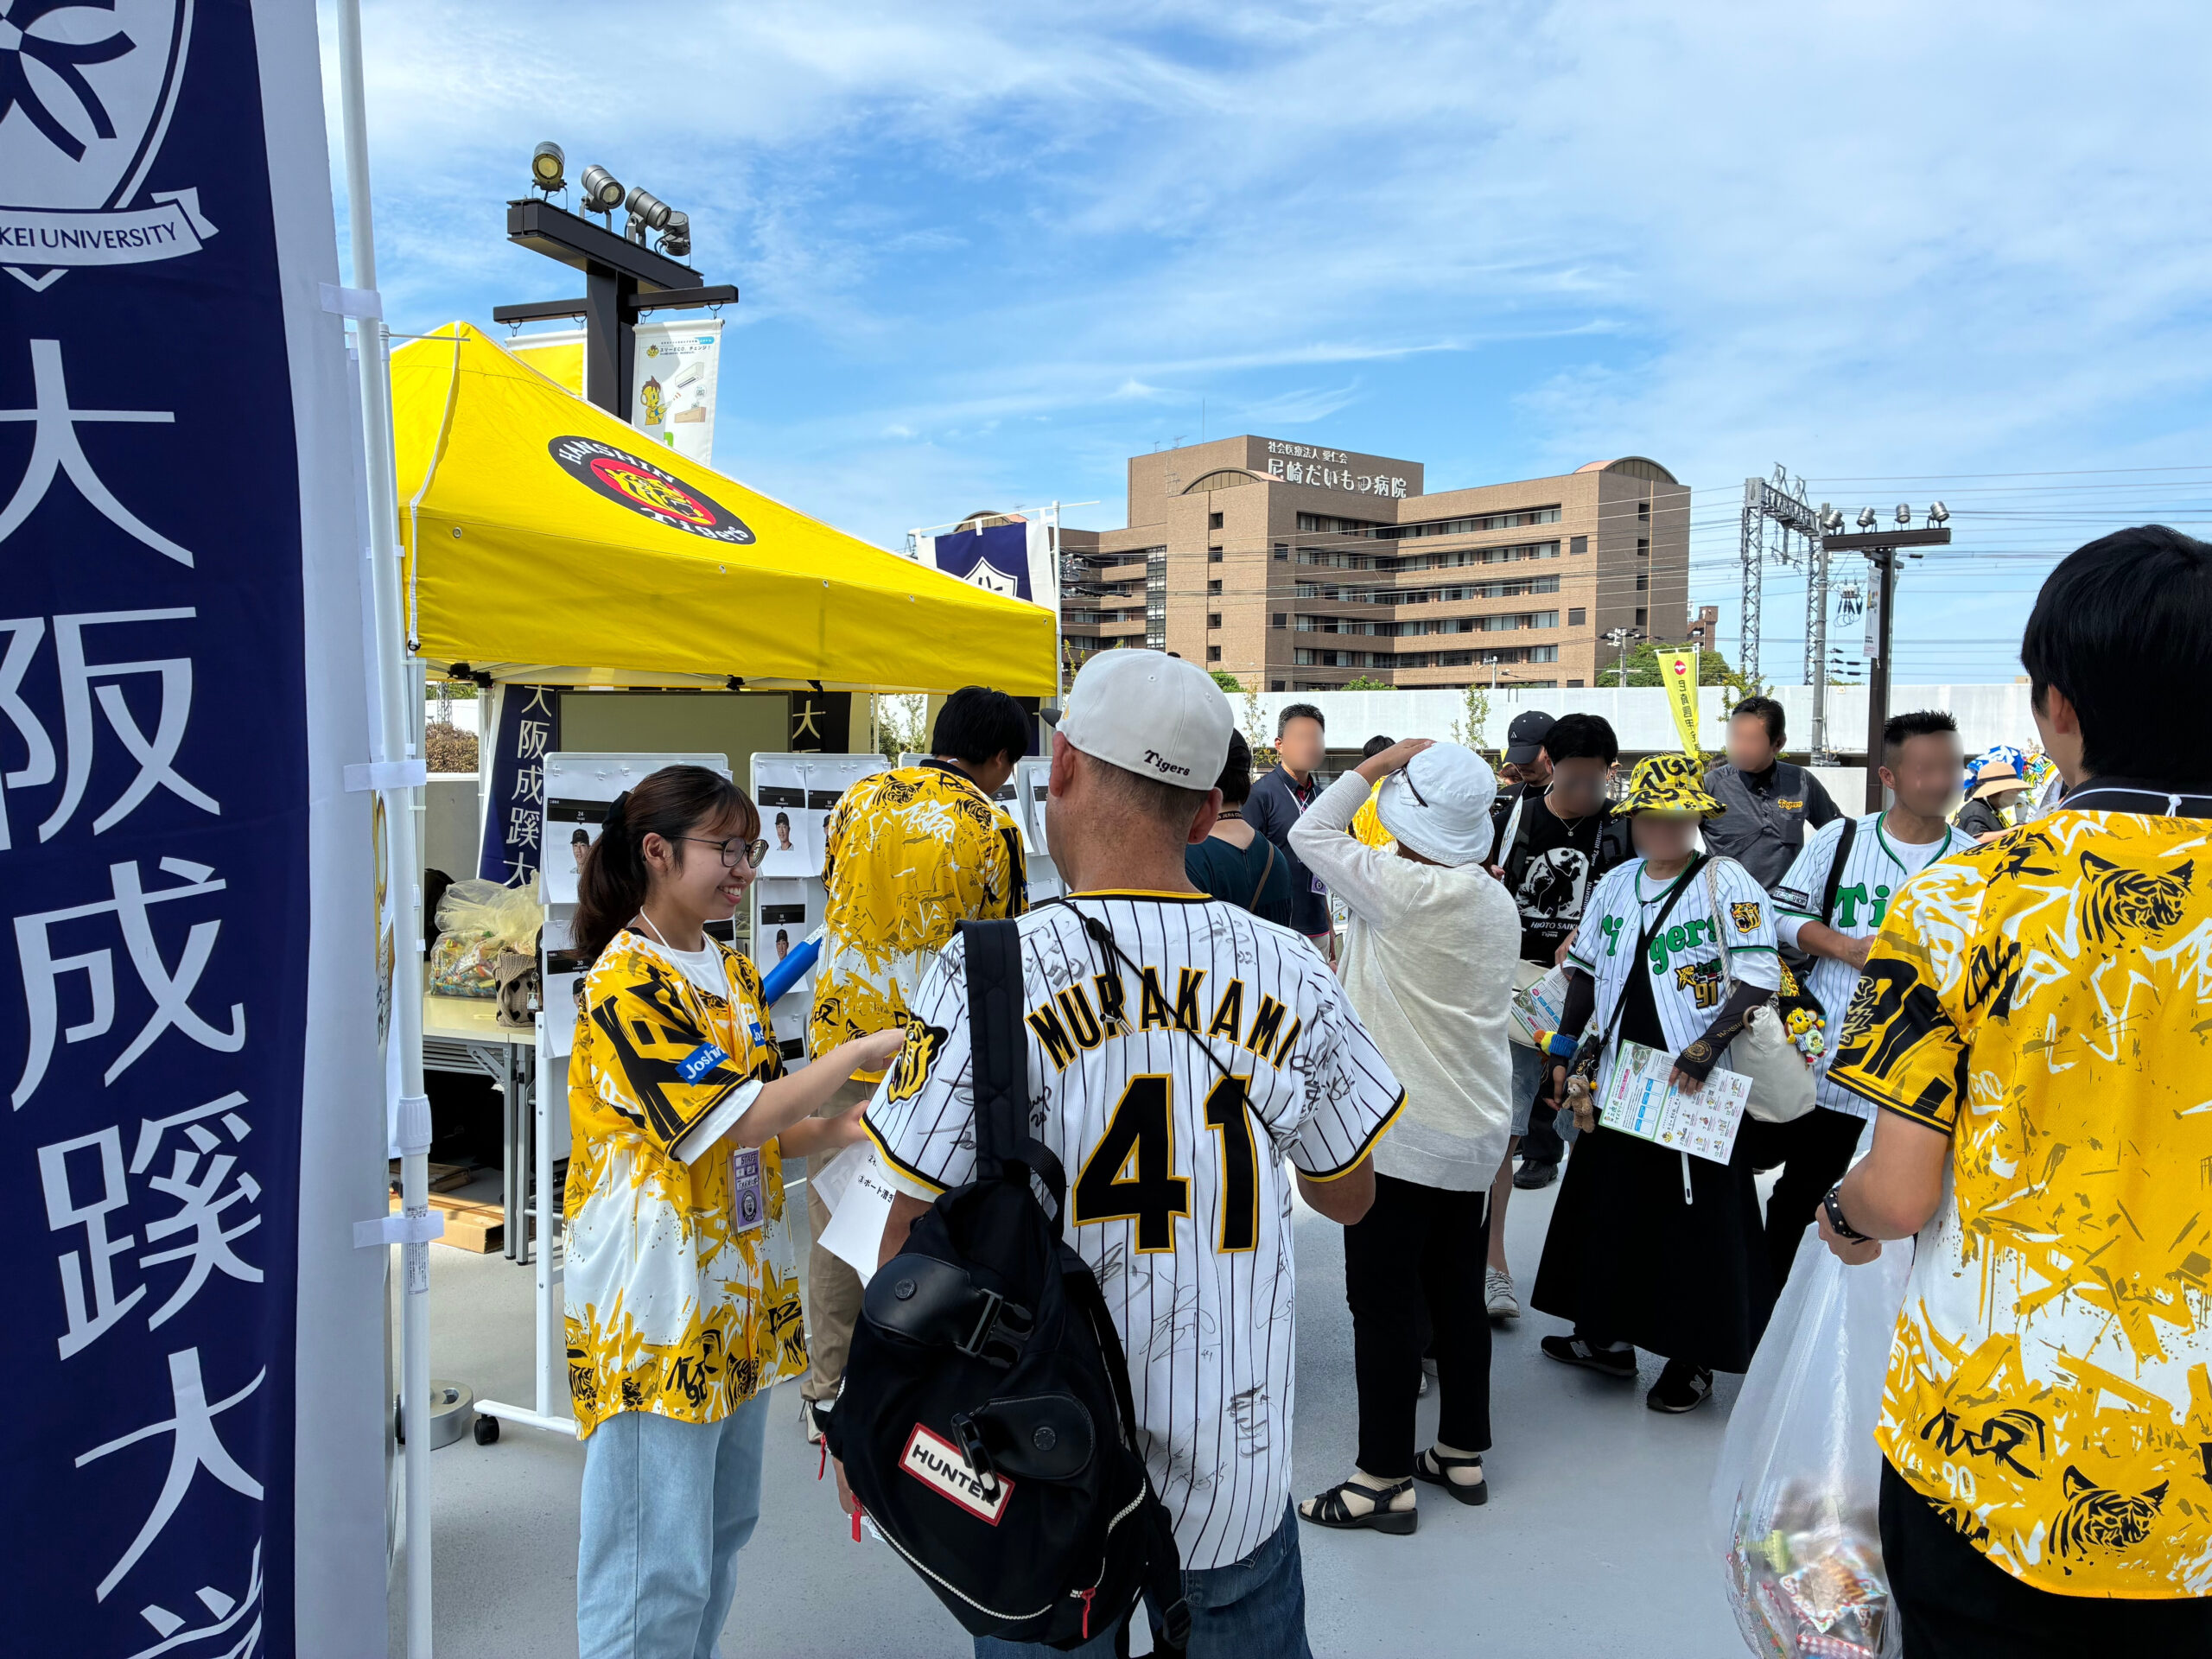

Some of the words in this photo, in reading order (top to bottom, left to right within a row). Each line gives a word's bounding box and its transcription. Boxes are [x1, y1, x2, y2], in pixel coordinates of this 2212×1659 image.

[41, 221, 176, 249] UNIVERSITY
[558, 441, 675, 484] HANSHIN
[1268, 441, 1319, 461] 社会医療法人
[1322, 450, 1348, 465] 愛仁会
[1268, 458, 1407, 499] 尼崎だいもつ病院
[640, 507, 749, 542] Tigers
[1144, 749, 1190, 776] Tigers
[1694, 980, 1717, 1008] 91
[1024, 965, 1302, 1072] MURAKAMI
[1071, 1072, 1258, 1255] 41
[912, 1444, 995, 1507] HUNTE
